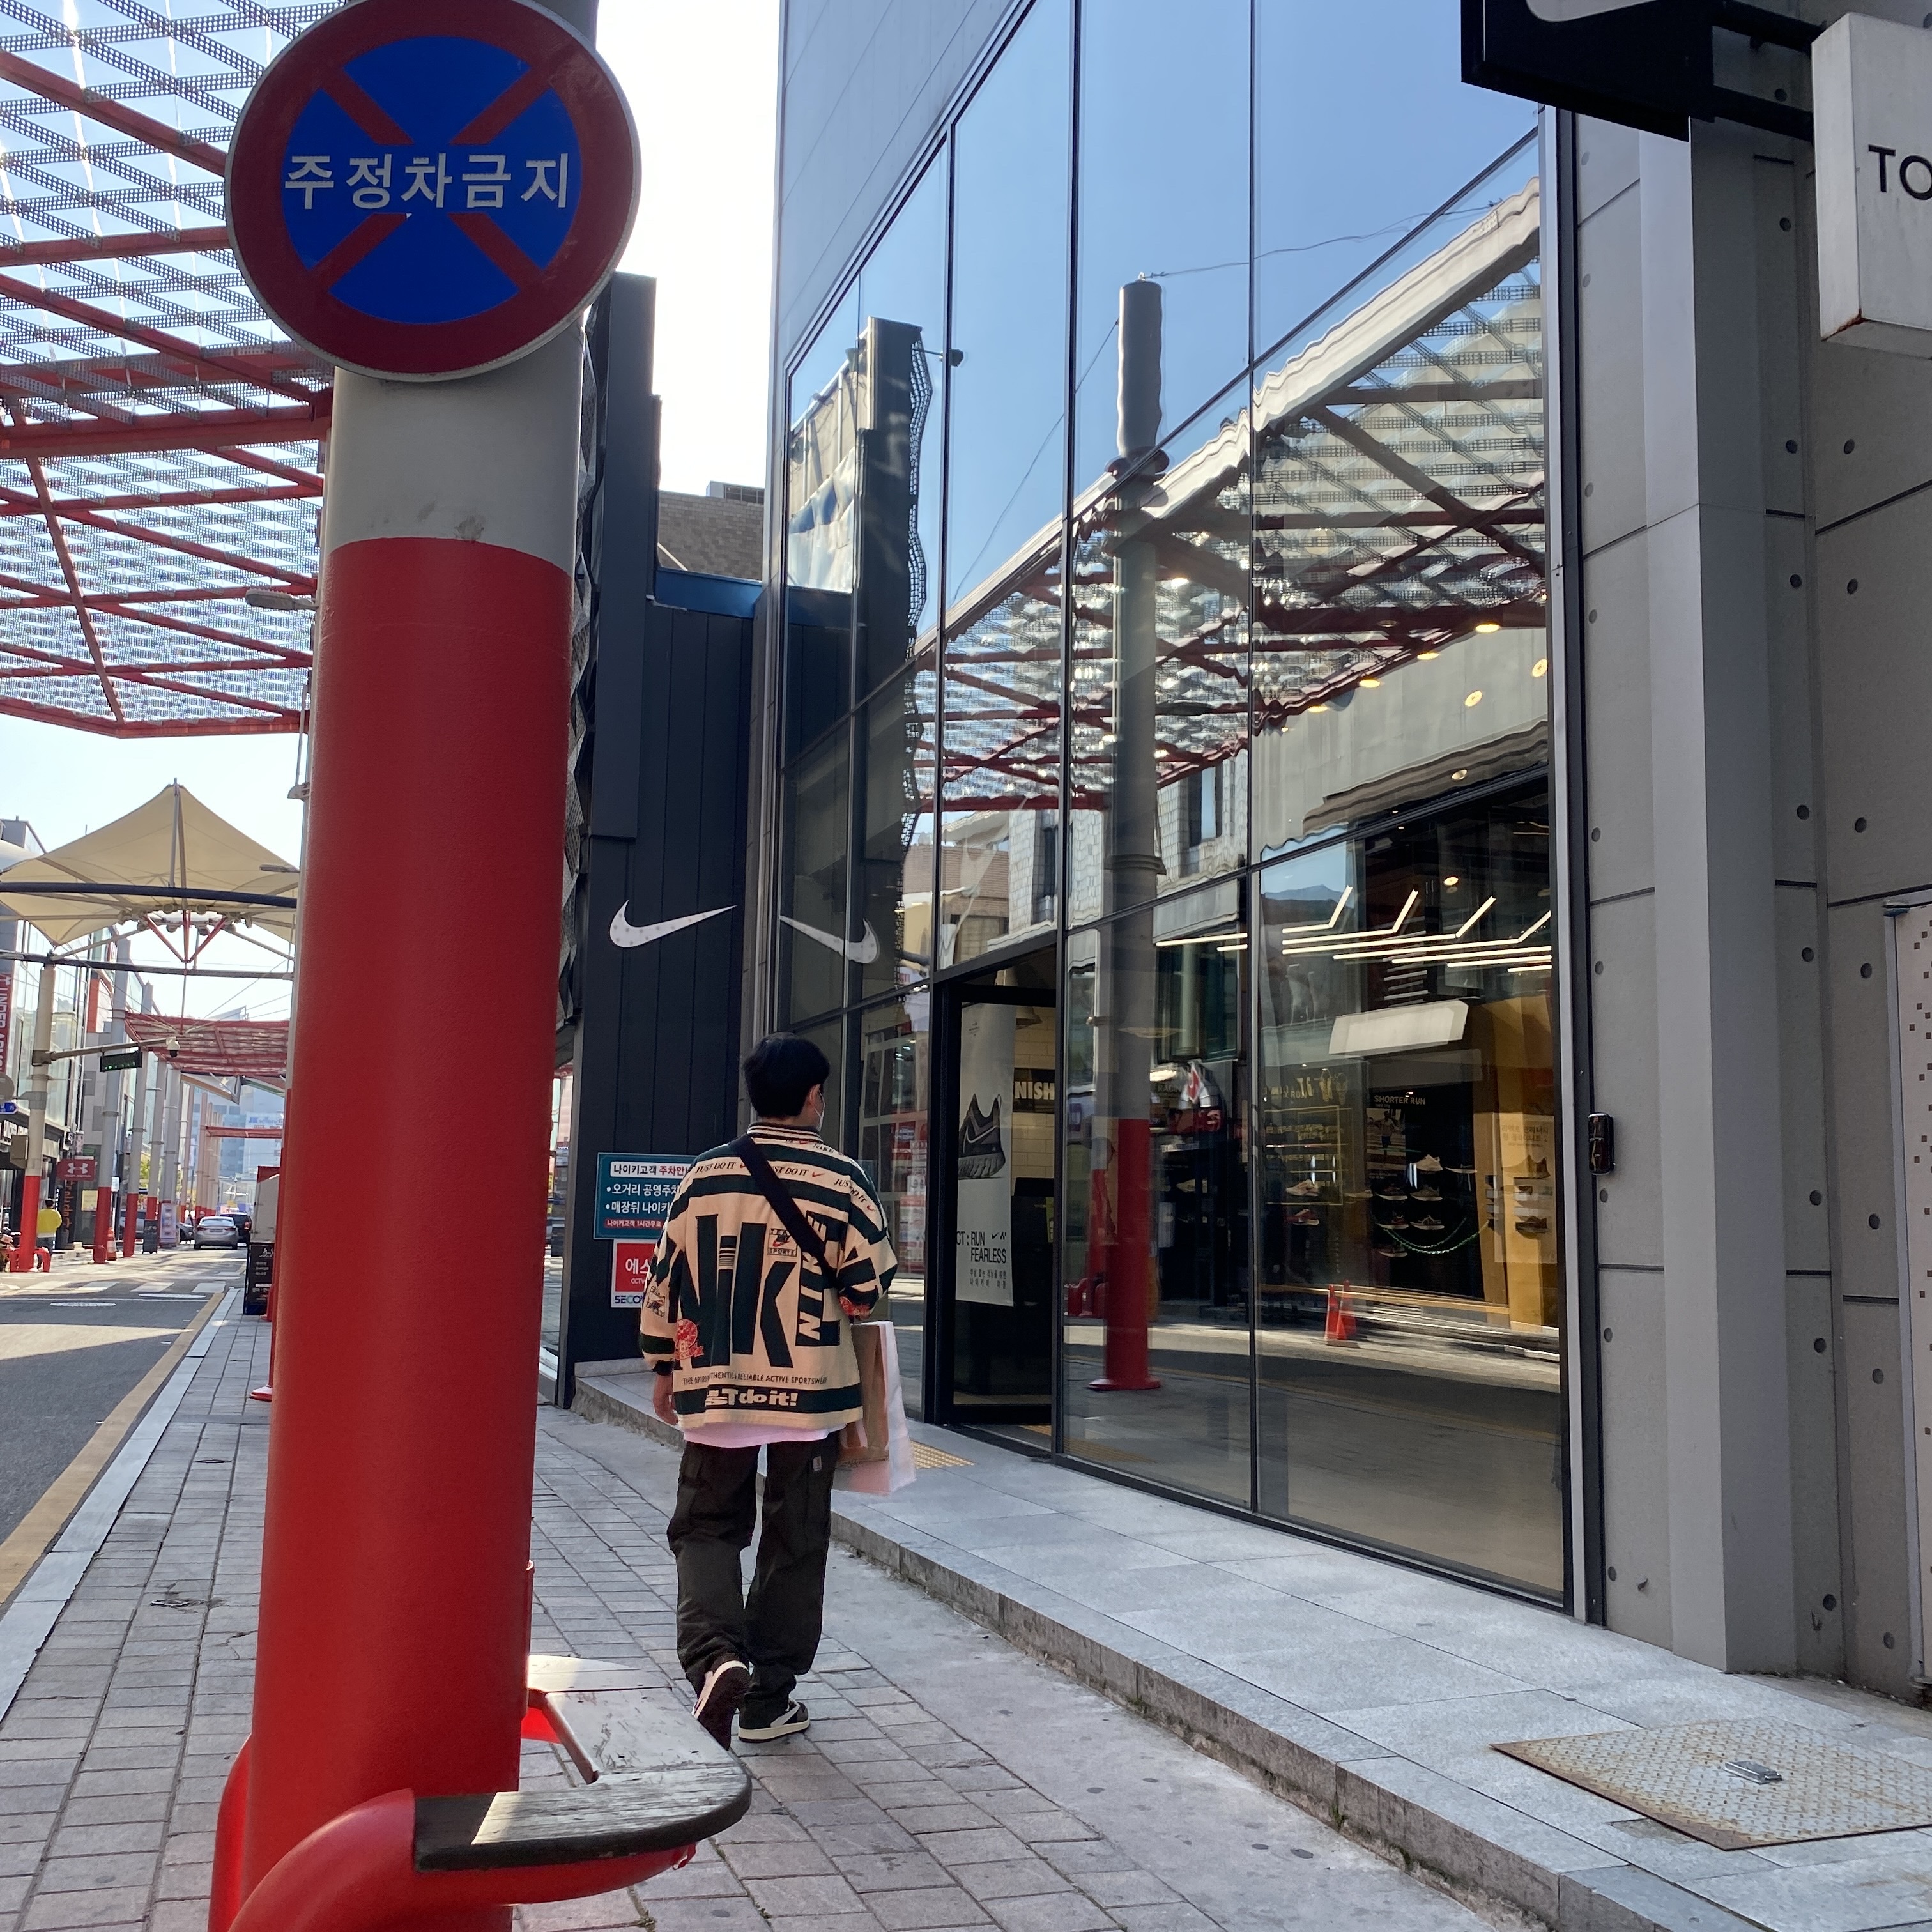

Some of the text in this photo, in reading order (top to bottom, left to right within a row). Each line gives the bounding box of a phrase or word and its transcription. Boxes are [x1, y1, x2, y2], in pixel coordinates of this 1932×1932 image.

[1868, 144, 1932, 200] TO
[284, 153, 569, 209] 주정차금지
[1015, 1081, 1055, 1100] NISH
[1374, 1095, 1426, 1105] SHORTER RUN
[613, 1164, 657, 1176] 나이키고객
[696, 1163, 714, 1174] JUST
[772, 1165, 783, 1174] ST
[833, 1179, 851, 1187] JUS
[612, 1183, 640, 1196] 오거리
[611, 1201, 670, 1214] 매장뒤 나이키
[607, 1219, 635, 1227] 나이키고객
[971, 1231, 985, 1246] RUN
[769, 1247, 796, 1256] SPORTS
[971, 1247, 1006, 1264] FEARLESS
[683, 1377, 693, 1386] THE
[765, 1376, 789, 1384] ACTIVE
[739, 1389, 767, 1404] do
[769, 1390, 799, 1407] it!
